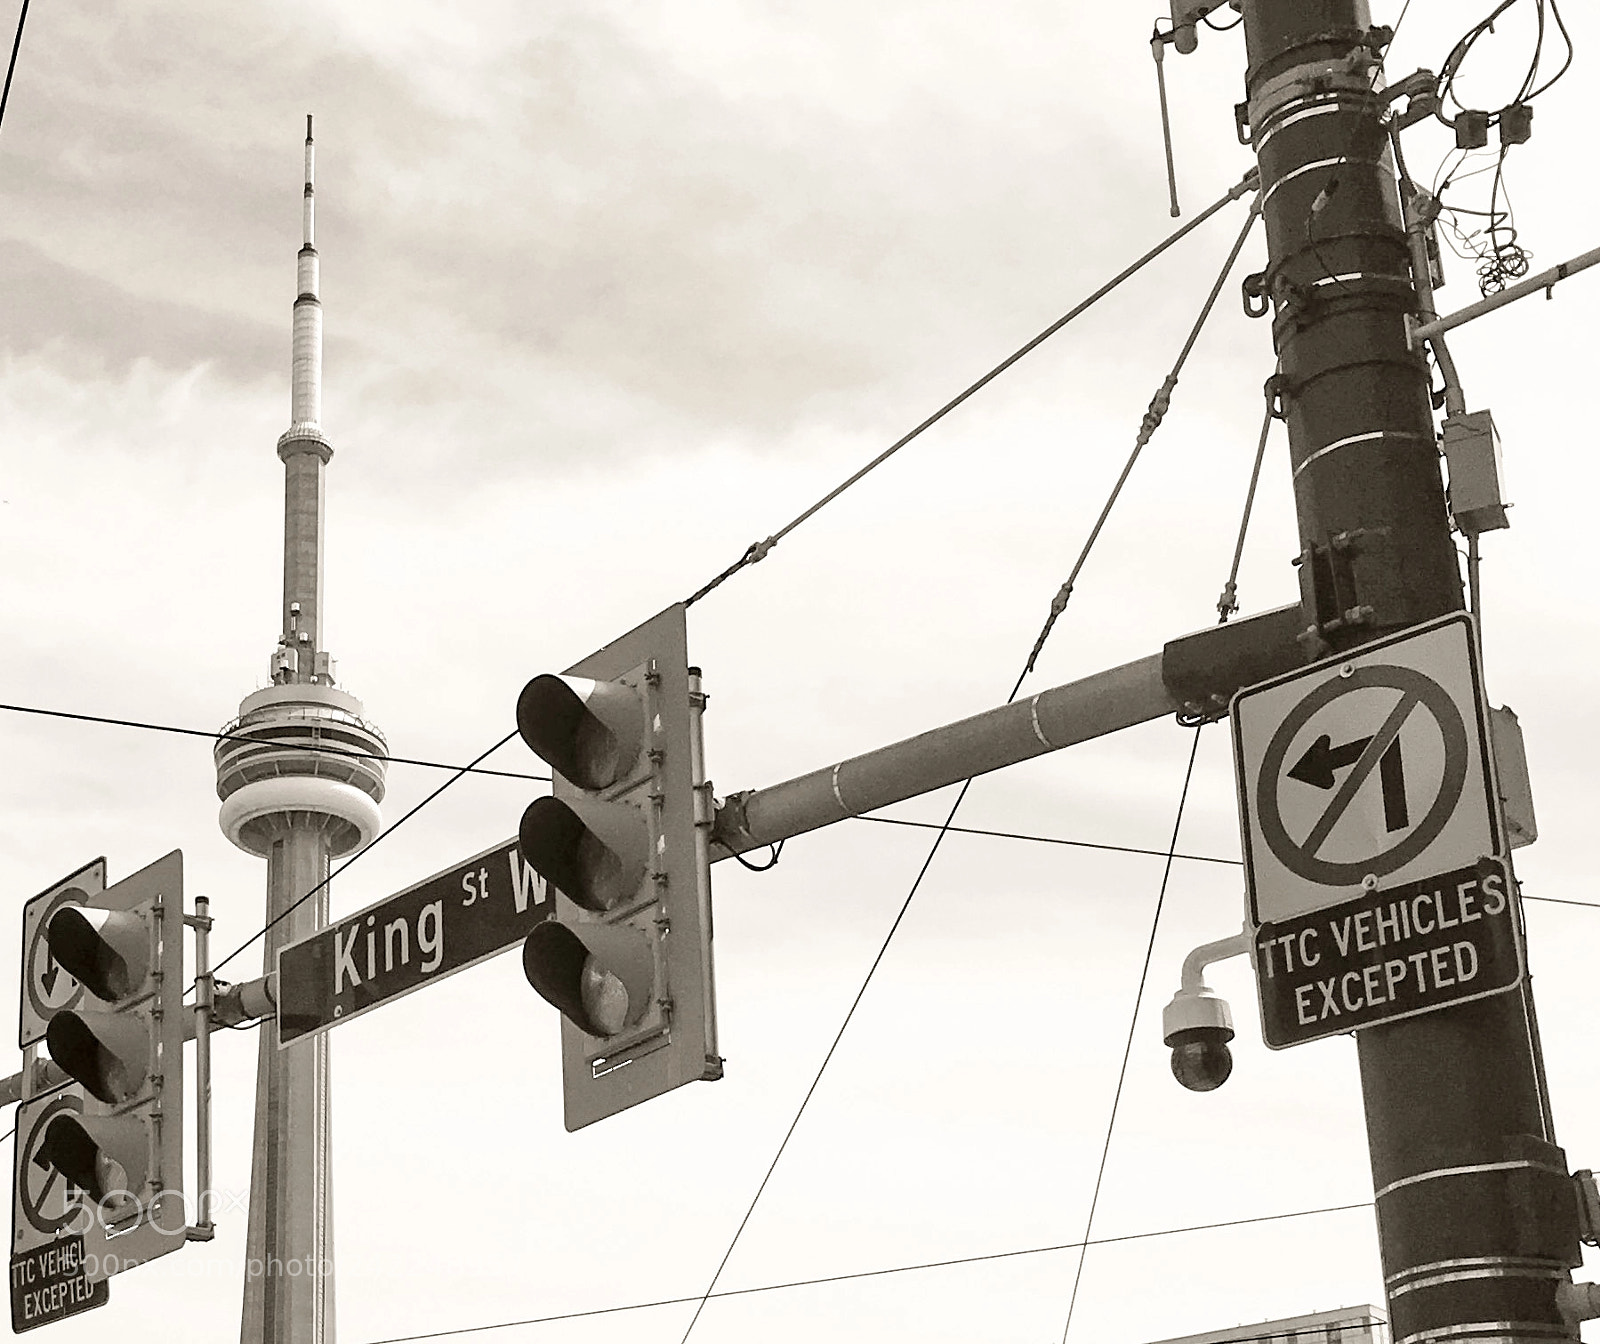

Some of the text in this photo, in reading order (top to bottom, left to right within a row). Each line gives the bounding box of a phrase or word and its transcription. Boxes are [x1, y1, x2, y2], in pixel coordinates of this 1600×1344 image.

[334, 848, 548, 994] King St W
[1259, 874, 1506, 978] TTC VEHICLES
[1295, 941, 1478, 1025] EXCEPTED
[12, 1240, 86, 1288] TTC VEHICL
[24, 1275, 94, 1320] EXCEPTED
